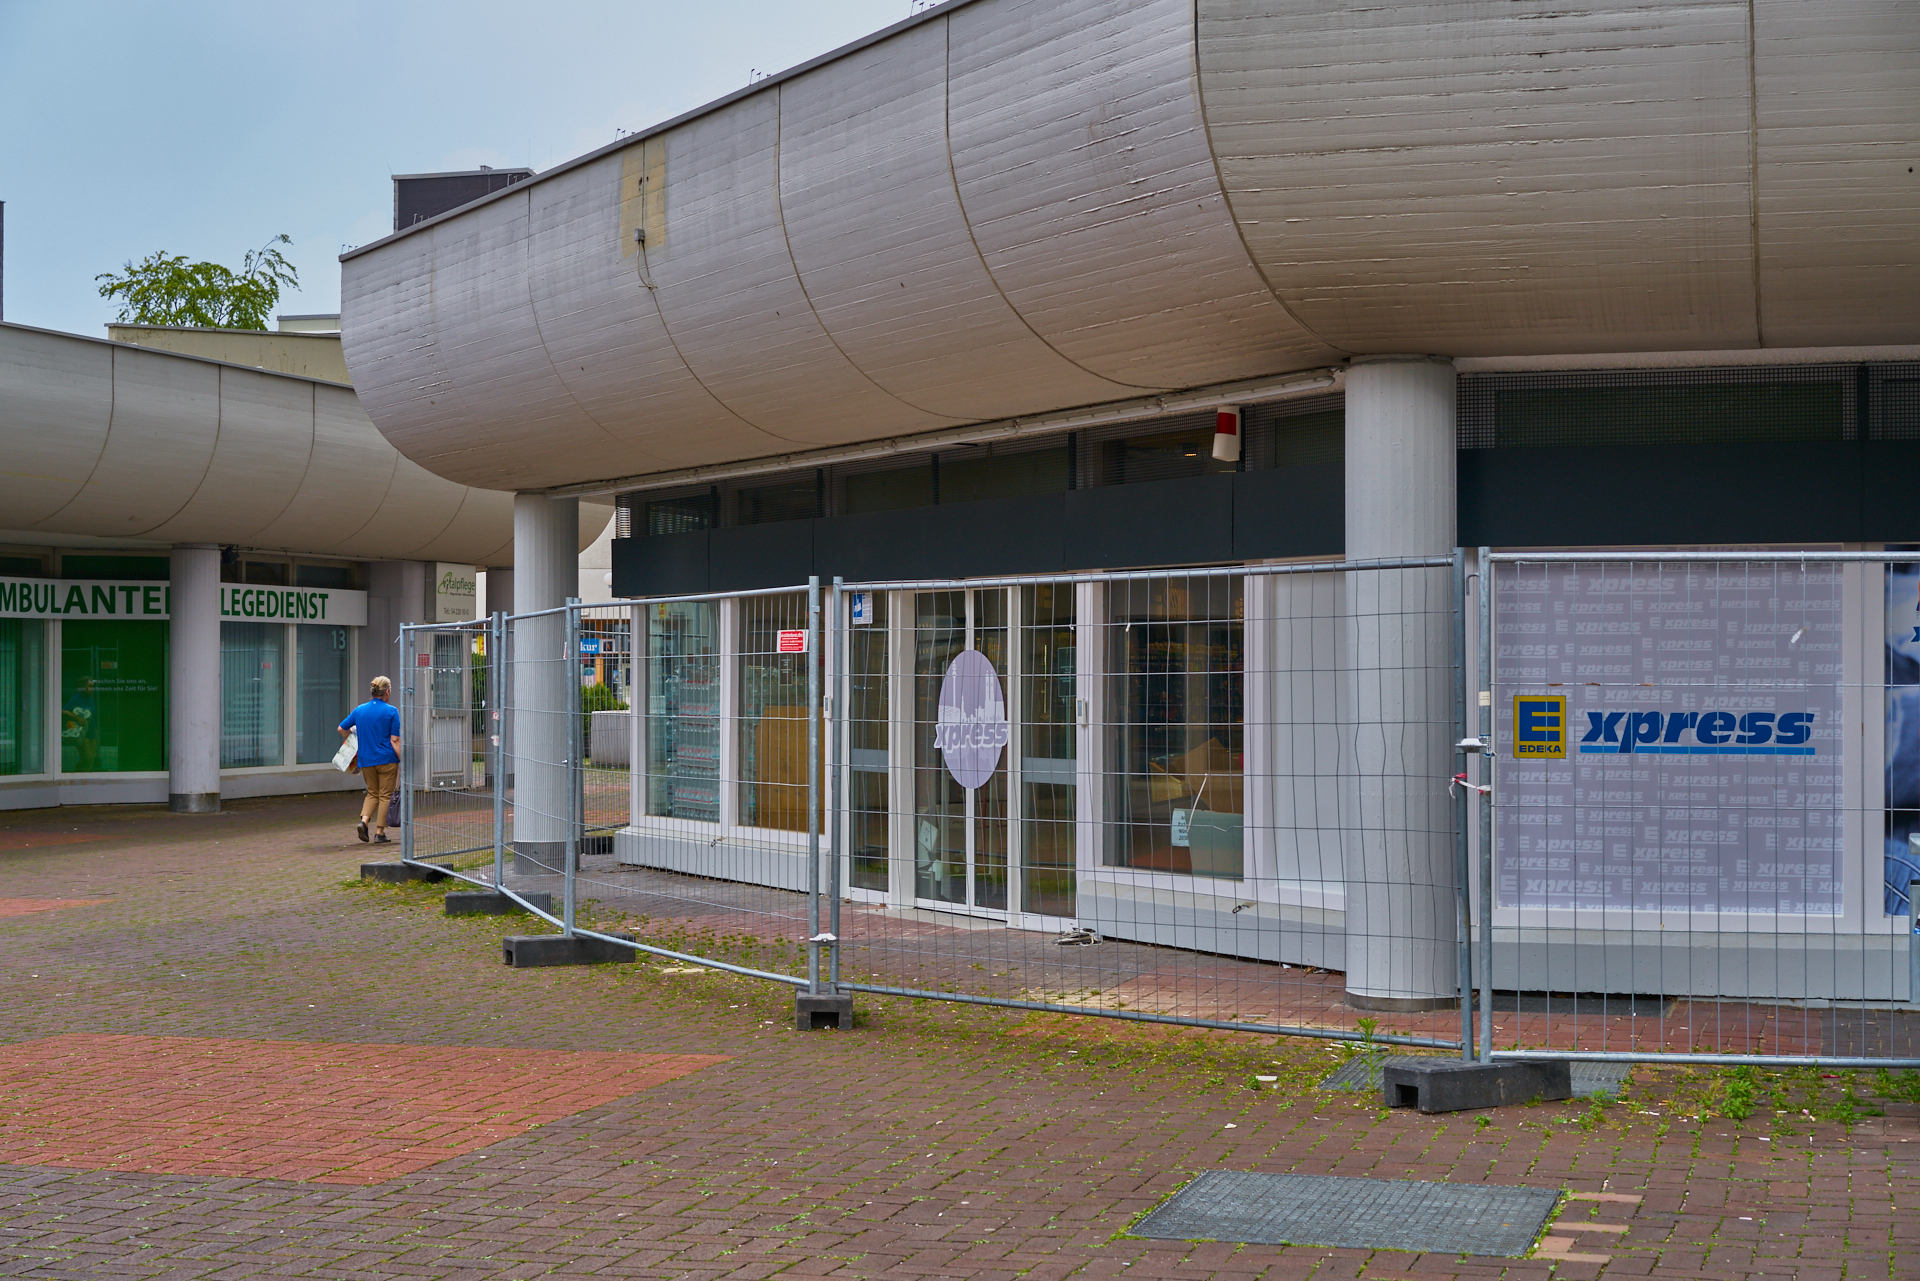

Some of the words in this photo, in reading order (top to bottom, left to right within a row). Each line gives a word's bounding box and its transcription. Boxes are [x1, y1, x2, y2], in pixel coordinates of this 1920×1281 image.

[1587, 578, 1675, 593] xpress
[1705, 577, 1771, 588] xpress
[0, 582, 170, 614] MBULANTE
[221, 588, 328, 619] LEGEDIENST
[1569, 603, 1623, 613] xpress
[1648, 601, 1703, 612] xpress
[1721, 600, 1760, 608] xpress
[1785, 599, 1840, 610] xpress
[1575, 622, 1641, 634] xpress
[1664, 618, 1718, 629] xpress
[1743, 622, 1798, 634] xpress
[332, 630, 346, 650] 13
[1657, 640, 1712, 650] xpress
[1738, 640, 1775, 648] xpress
[1580, 645, 1631, 655] xpress
[1658, 661, 1713, 670] xpress
[1735, 658, 1791, 668] xpress
[1577, 665, 1631, 675] xpress
[1605, 690, 1673, 702] xpress
[1702, 697, 1775, 709] xpress
[934, 723, 1008, 752] xpress
[1581, 711, 1815, 753] xpress
[1519, 745, 1561, 753] EDEKA
[1507, 771, 1572, 782] xpress
[1596, 770, 1649, 780] xpress
[1673, 775, 1729, 785] xpress
[1512, 795, 1563, 804] xpress
[1588, 791, 1643, 801] xpress
[1730, 795, 1768, 803] xpress
[1508, 814, 1562, 824] xpress
[1589, 811, 1643, 821] xpress
[1666, 809, 1720, 819] xpress
[1744, 817, 1800, 827] xpress
[1588, 827, 1635, 835] xpress
[1665, 830, 1738, 842] xpress
[1536, 839, 1603, 852] xpress
[1633, 848, 1706, 860] xpress
[1504, 857, 1570, 869] xpress
[1594, 864, 1643, 875] xpress
[1673, 866, 1723, 875] xpress
[1757, 863, 1831, 877] xpress
[1524, 879, 1612, 895] xpress
[1641, 882, 1707, 894] xpress
[1733, 881, 1789, 891] xpress
